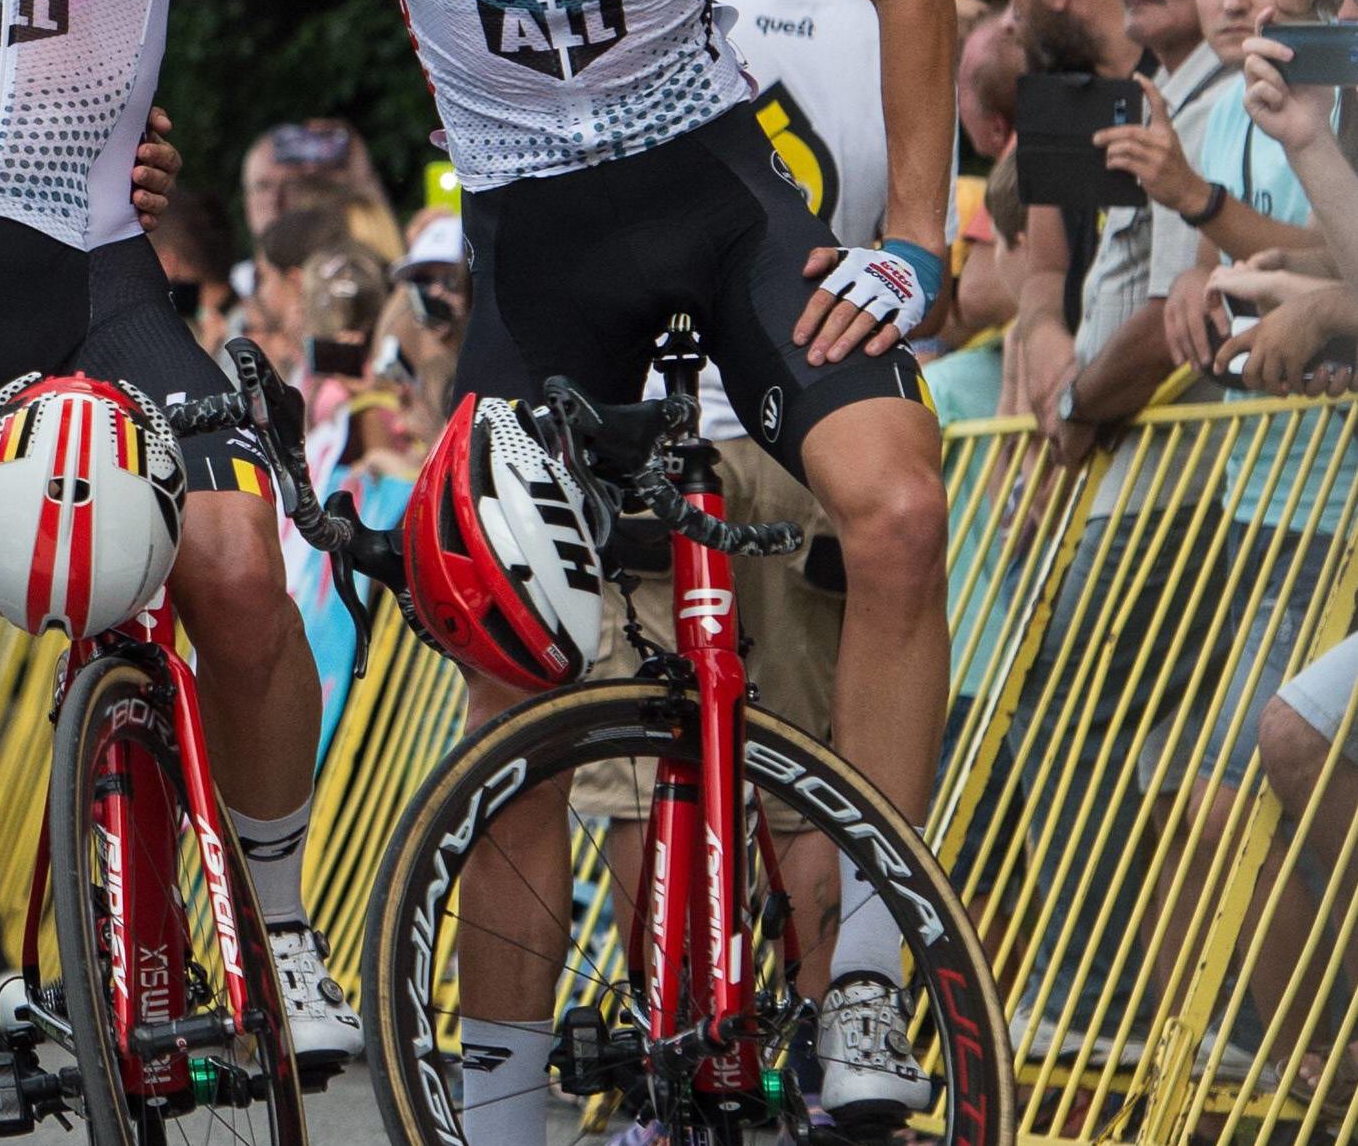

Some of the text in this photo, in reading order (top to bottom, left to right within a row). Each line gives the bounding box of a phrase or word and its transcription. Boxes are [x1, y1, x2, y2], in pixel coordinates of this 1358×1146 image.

[499, 0, 622, 55] ALL
[864, 266, 907, 304] SOUDAL
[195, 812, 244, 980] RIDLEY
[745, 740, 949, 946] BORA
[103, 831, 129, 998] RIDLEY
[140, 943, 170, 987] SLX
